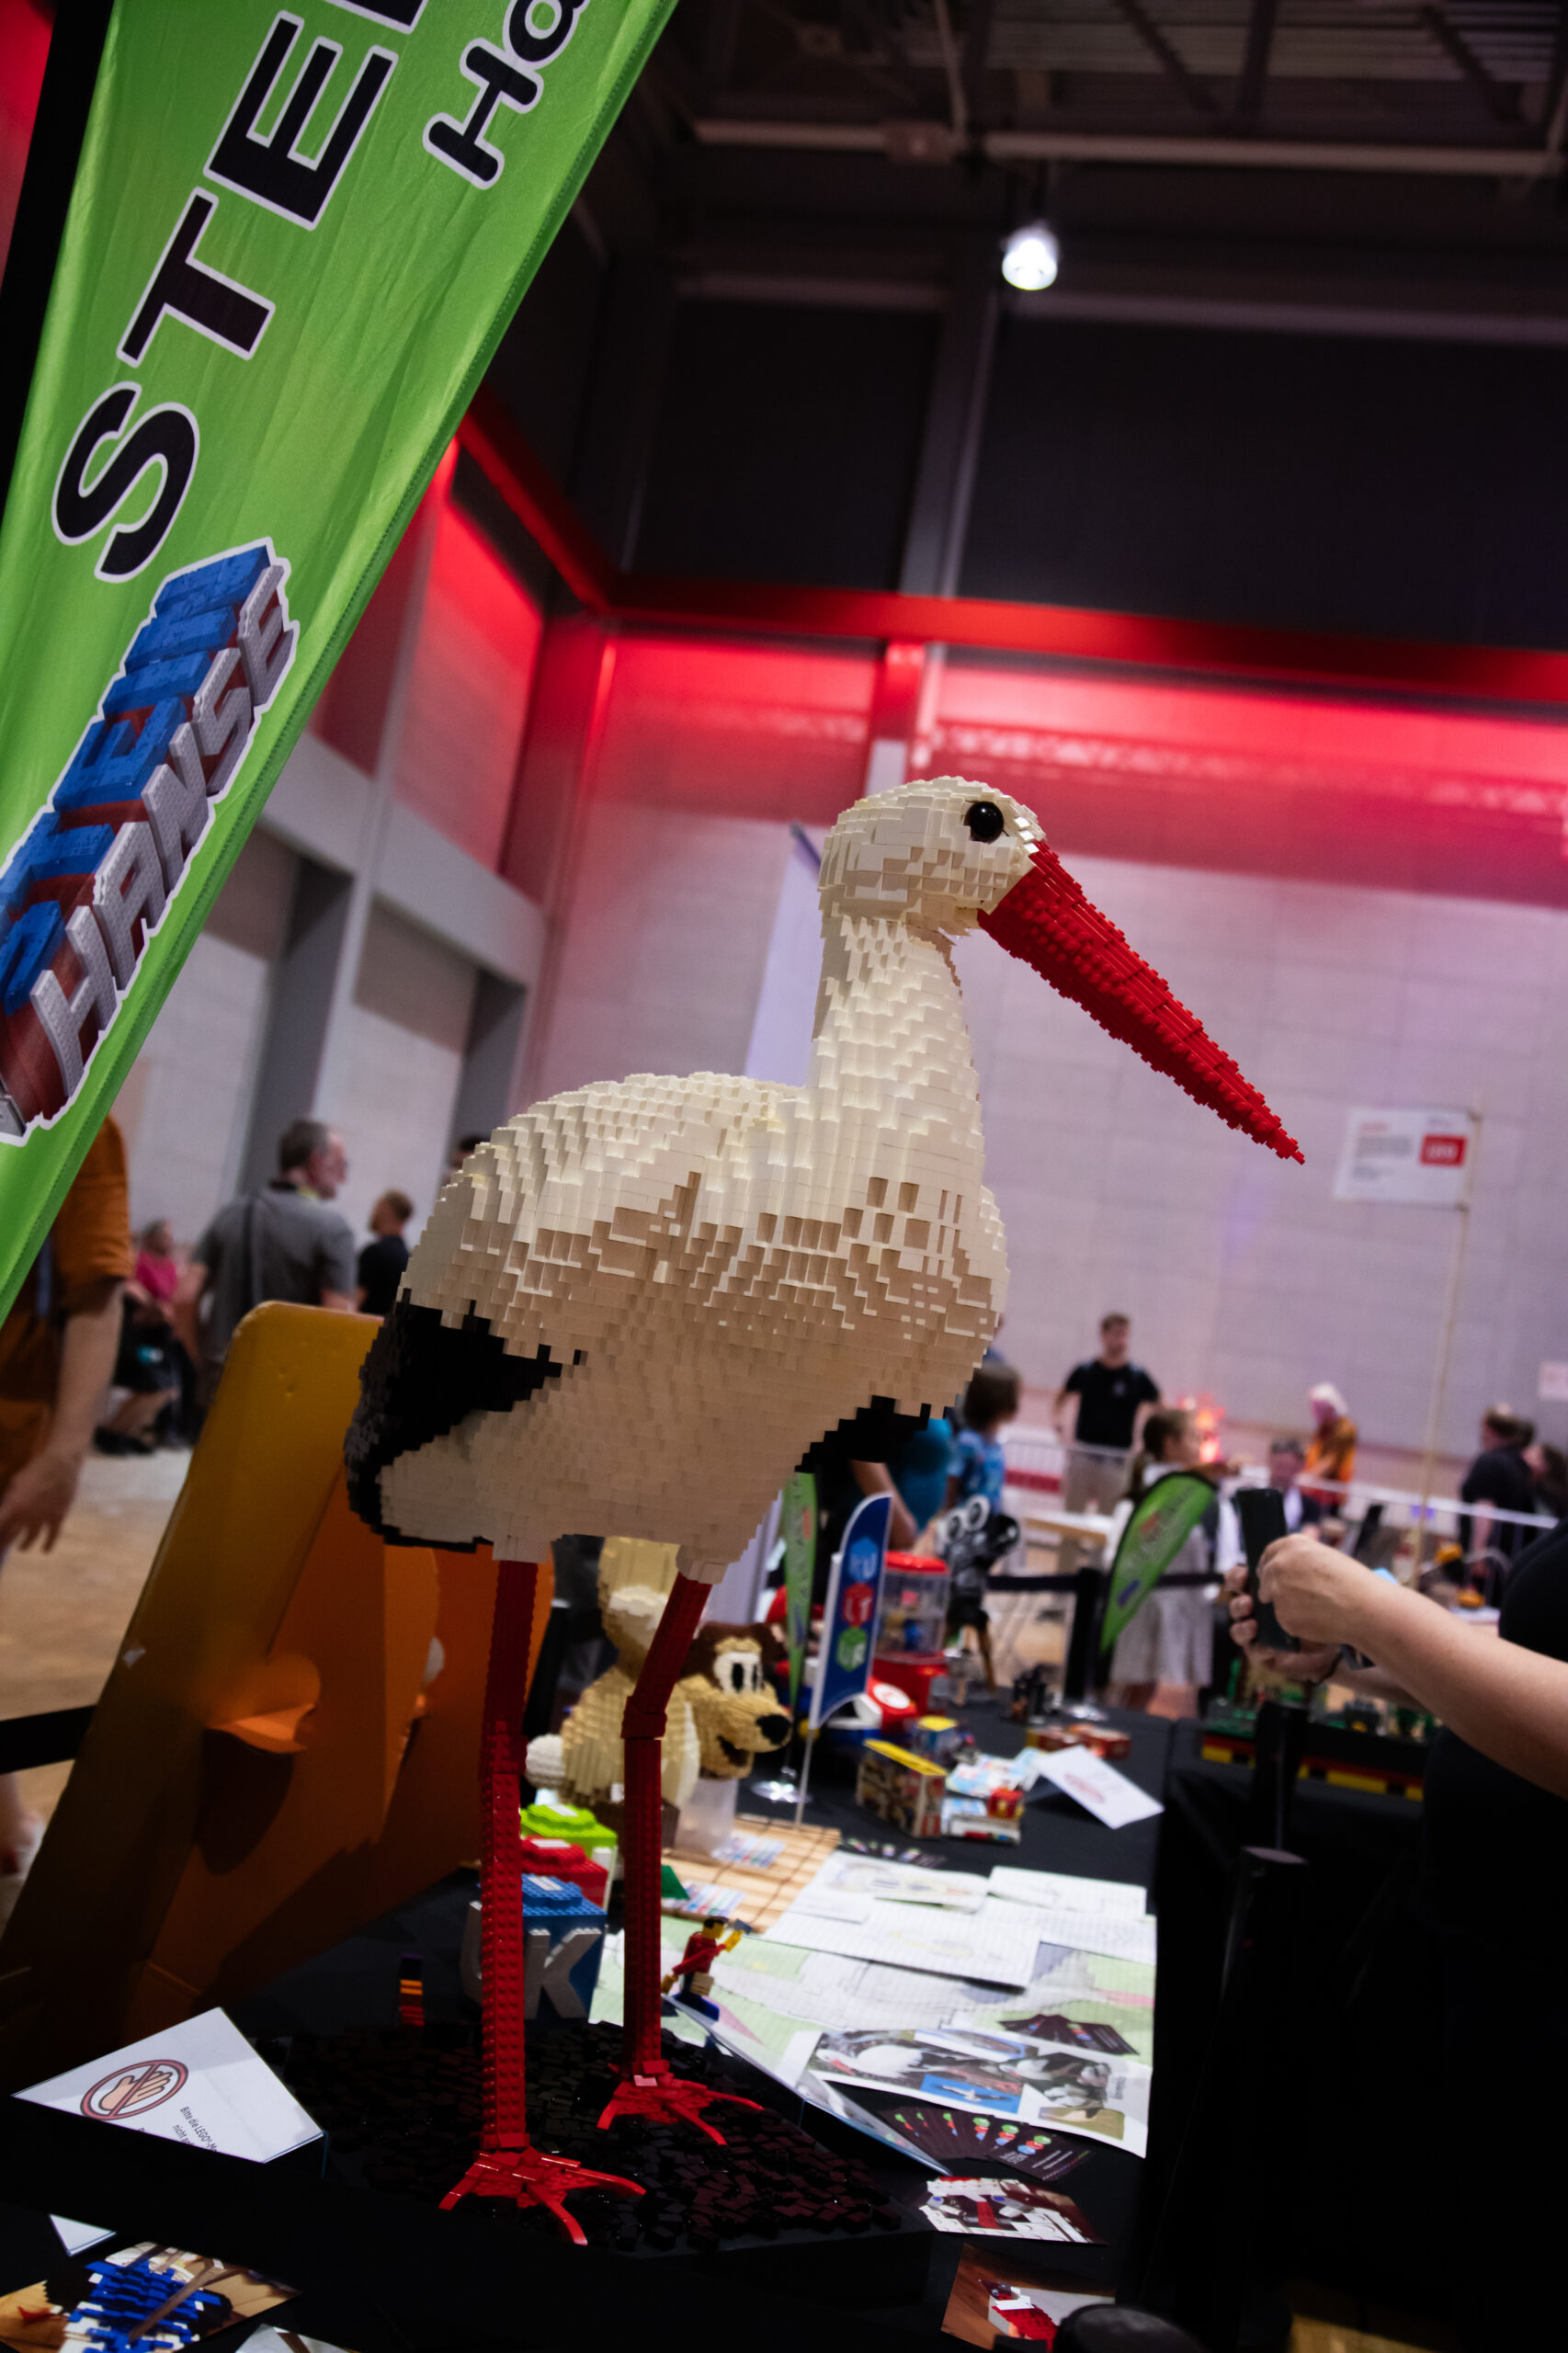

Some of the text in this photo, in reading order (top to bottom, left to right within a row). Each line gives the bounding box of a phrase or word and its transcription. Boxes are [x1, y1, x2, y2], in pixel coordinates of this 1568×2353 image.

[53, 0, 426, 581] STE
[30, 563, 297, 1097] HANSE
[173, 2124, 187, 2139] nicht
[180, 2106, 193, 2120] Bitte
[188, 2119, 199, 2128] die
